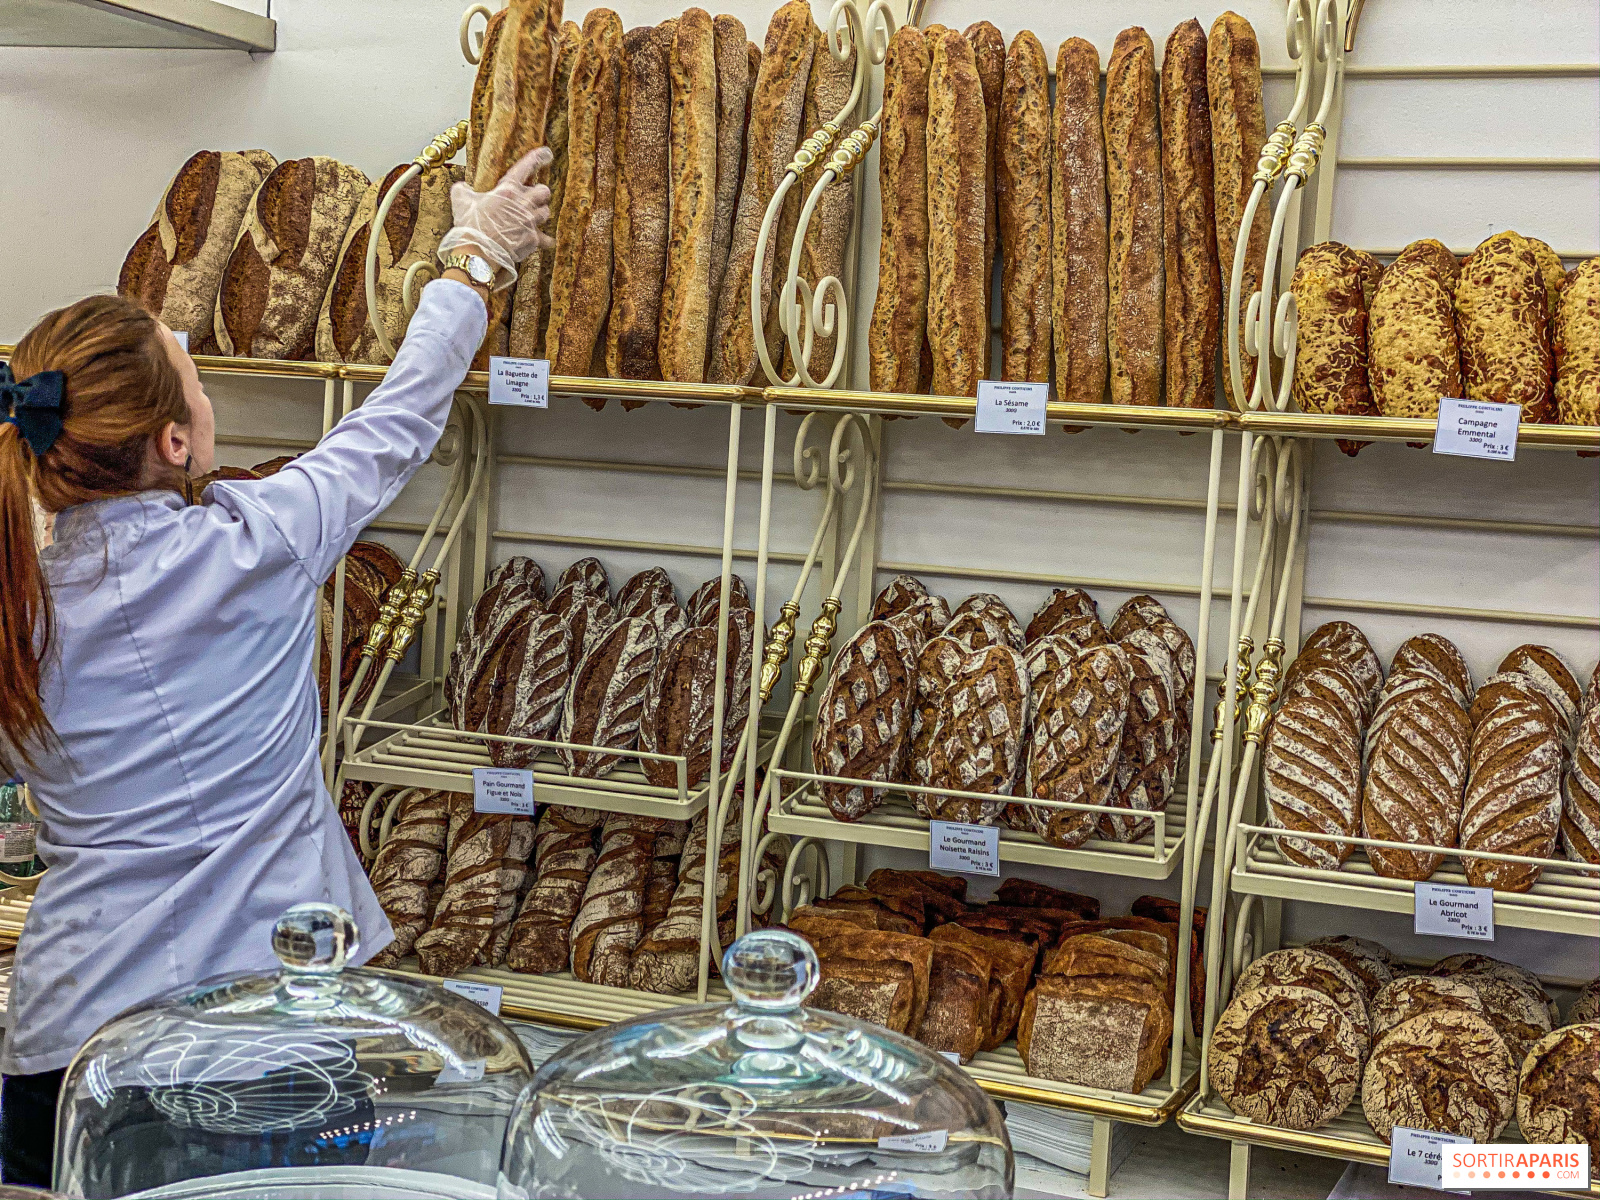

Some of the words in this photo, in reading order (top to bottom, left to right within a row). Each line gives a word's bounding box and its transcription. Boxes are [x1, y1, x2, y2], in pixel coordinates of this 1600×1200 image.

[506, 379, 528, 387] Limagne
[1458, 418, 1498, 428] Campagne
[1458, 428, 1496, 438] Emmental
[952, 837, 986, 846] Gourmand
[940, 845, 966, 853] Noisette
[1440, 900, 1478, 909] Gourmand
[1441, 910, 1467, 918] Abricot
[1425, 1152, 1442, 1160] céré
